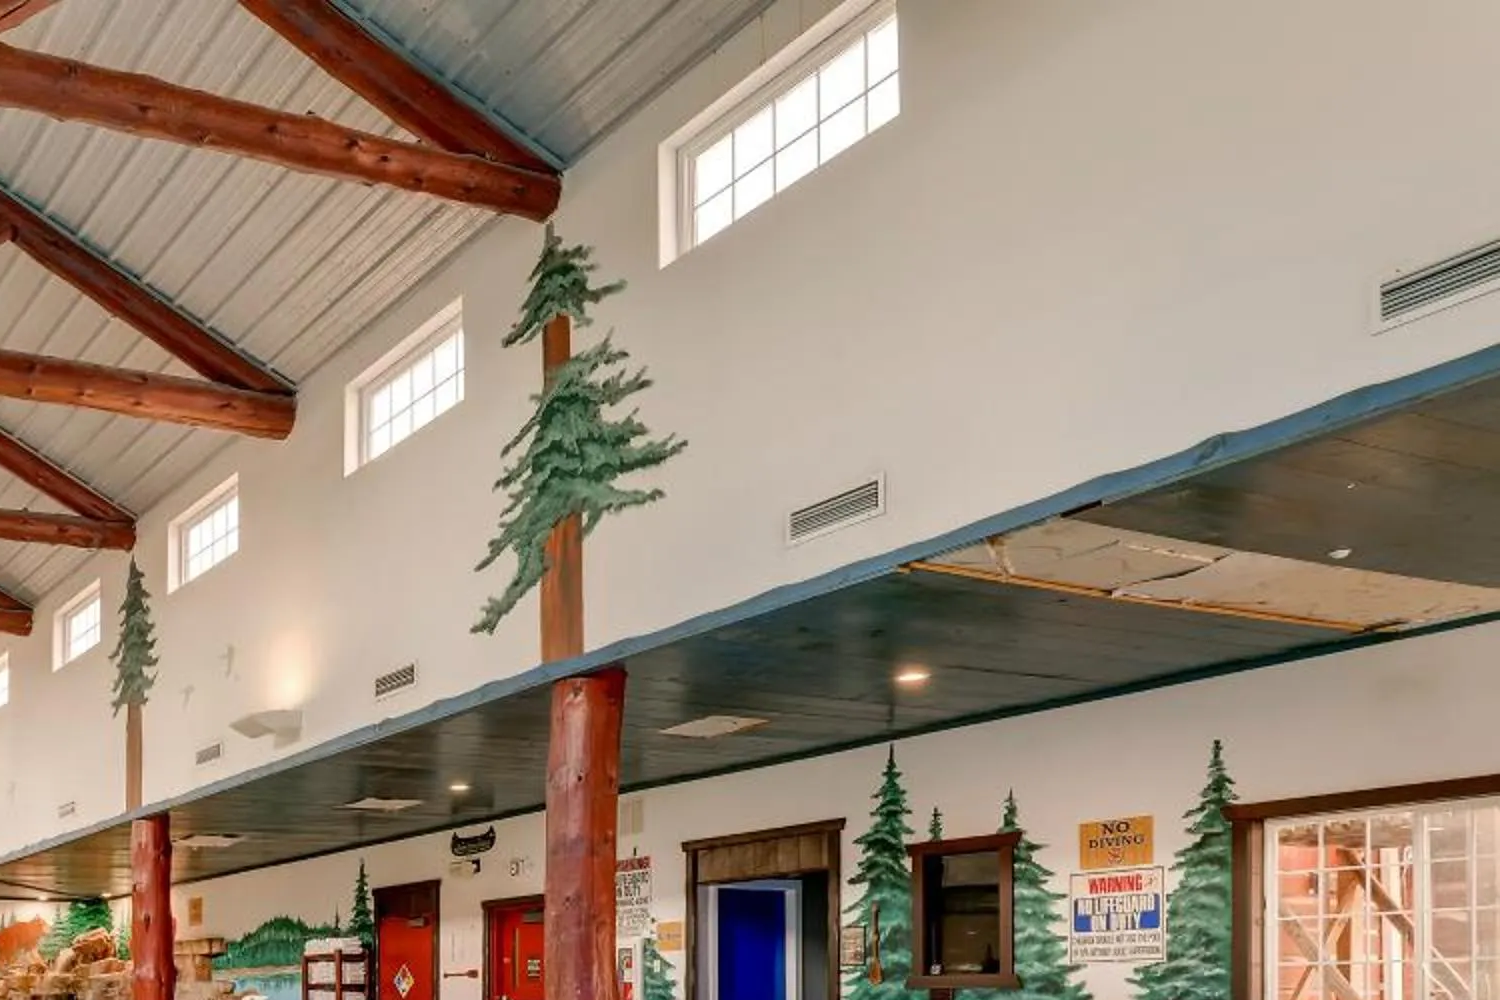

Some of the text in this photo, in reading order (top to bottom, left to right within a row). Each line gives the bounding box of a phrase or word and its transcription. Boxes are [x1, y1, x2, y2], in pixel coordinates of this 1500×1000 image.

[1102, 820, 1130, 835] NO
[1089, 832, 1145, 849] DIVING
[1088, 873, 1143, 895] WARNING
[1077, 895, 1155, 916] NO LIFEGUARD
[1091, 910, 1141, 932] ON DUTY
